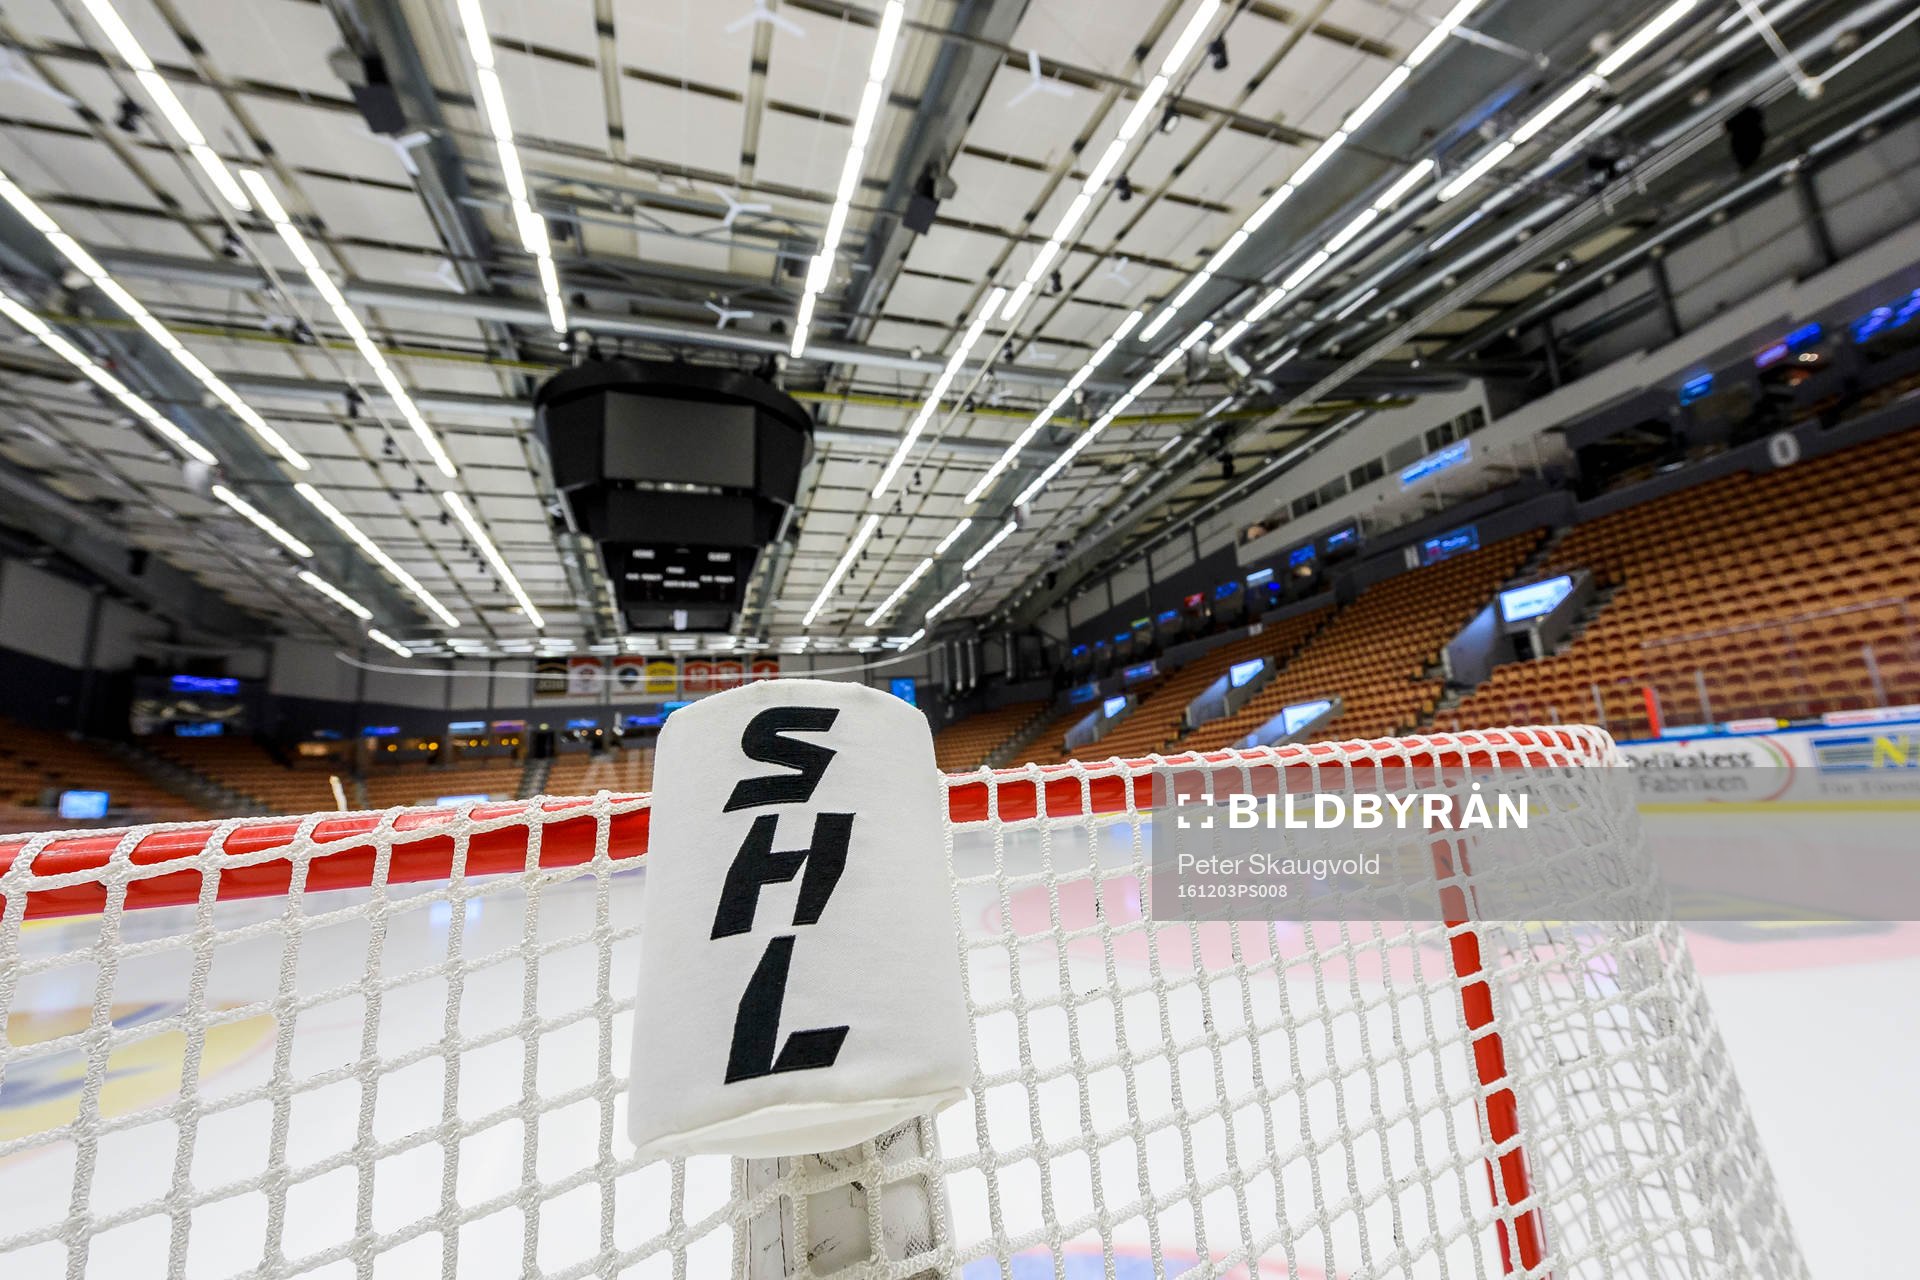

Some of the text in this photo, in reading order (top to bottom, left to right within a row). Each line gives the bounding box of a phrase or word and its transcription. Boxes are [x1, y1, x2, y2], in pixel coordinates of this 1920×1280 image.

[1873, 734, 1920, 768] N
[1638, 773, 1750, 793] Fabriken
[710, 706, 856, 1084] SHL
